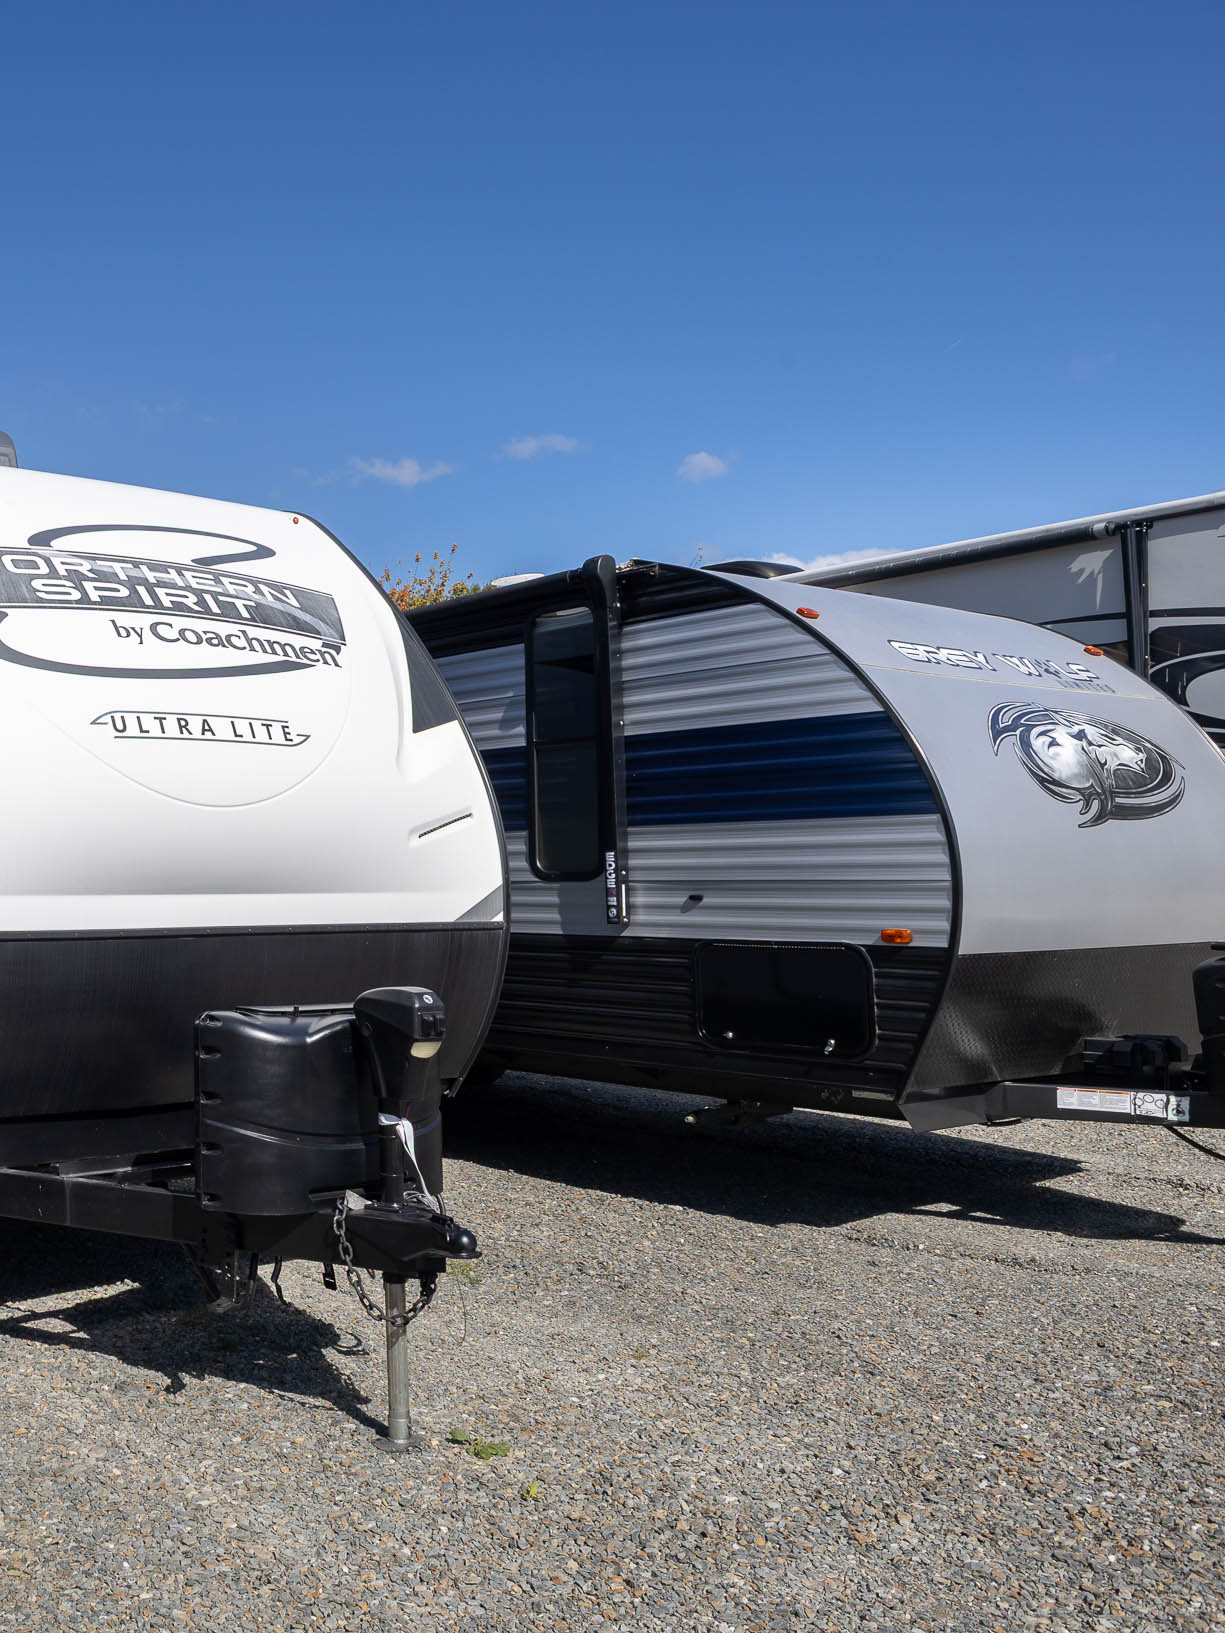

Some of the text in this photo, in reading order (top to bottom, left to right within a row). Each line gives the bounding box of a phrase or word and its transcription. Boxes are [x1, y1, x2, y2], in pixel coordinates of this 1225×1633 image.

[33, 577, 258, 619] SPIRIT
[109, 619, 343, 668] by Coachmen
[887, 639, 998, 672] GREY
[110, 714, 294, 743] ULTRA LITE
[605, 852, 616, 887] EDGE
